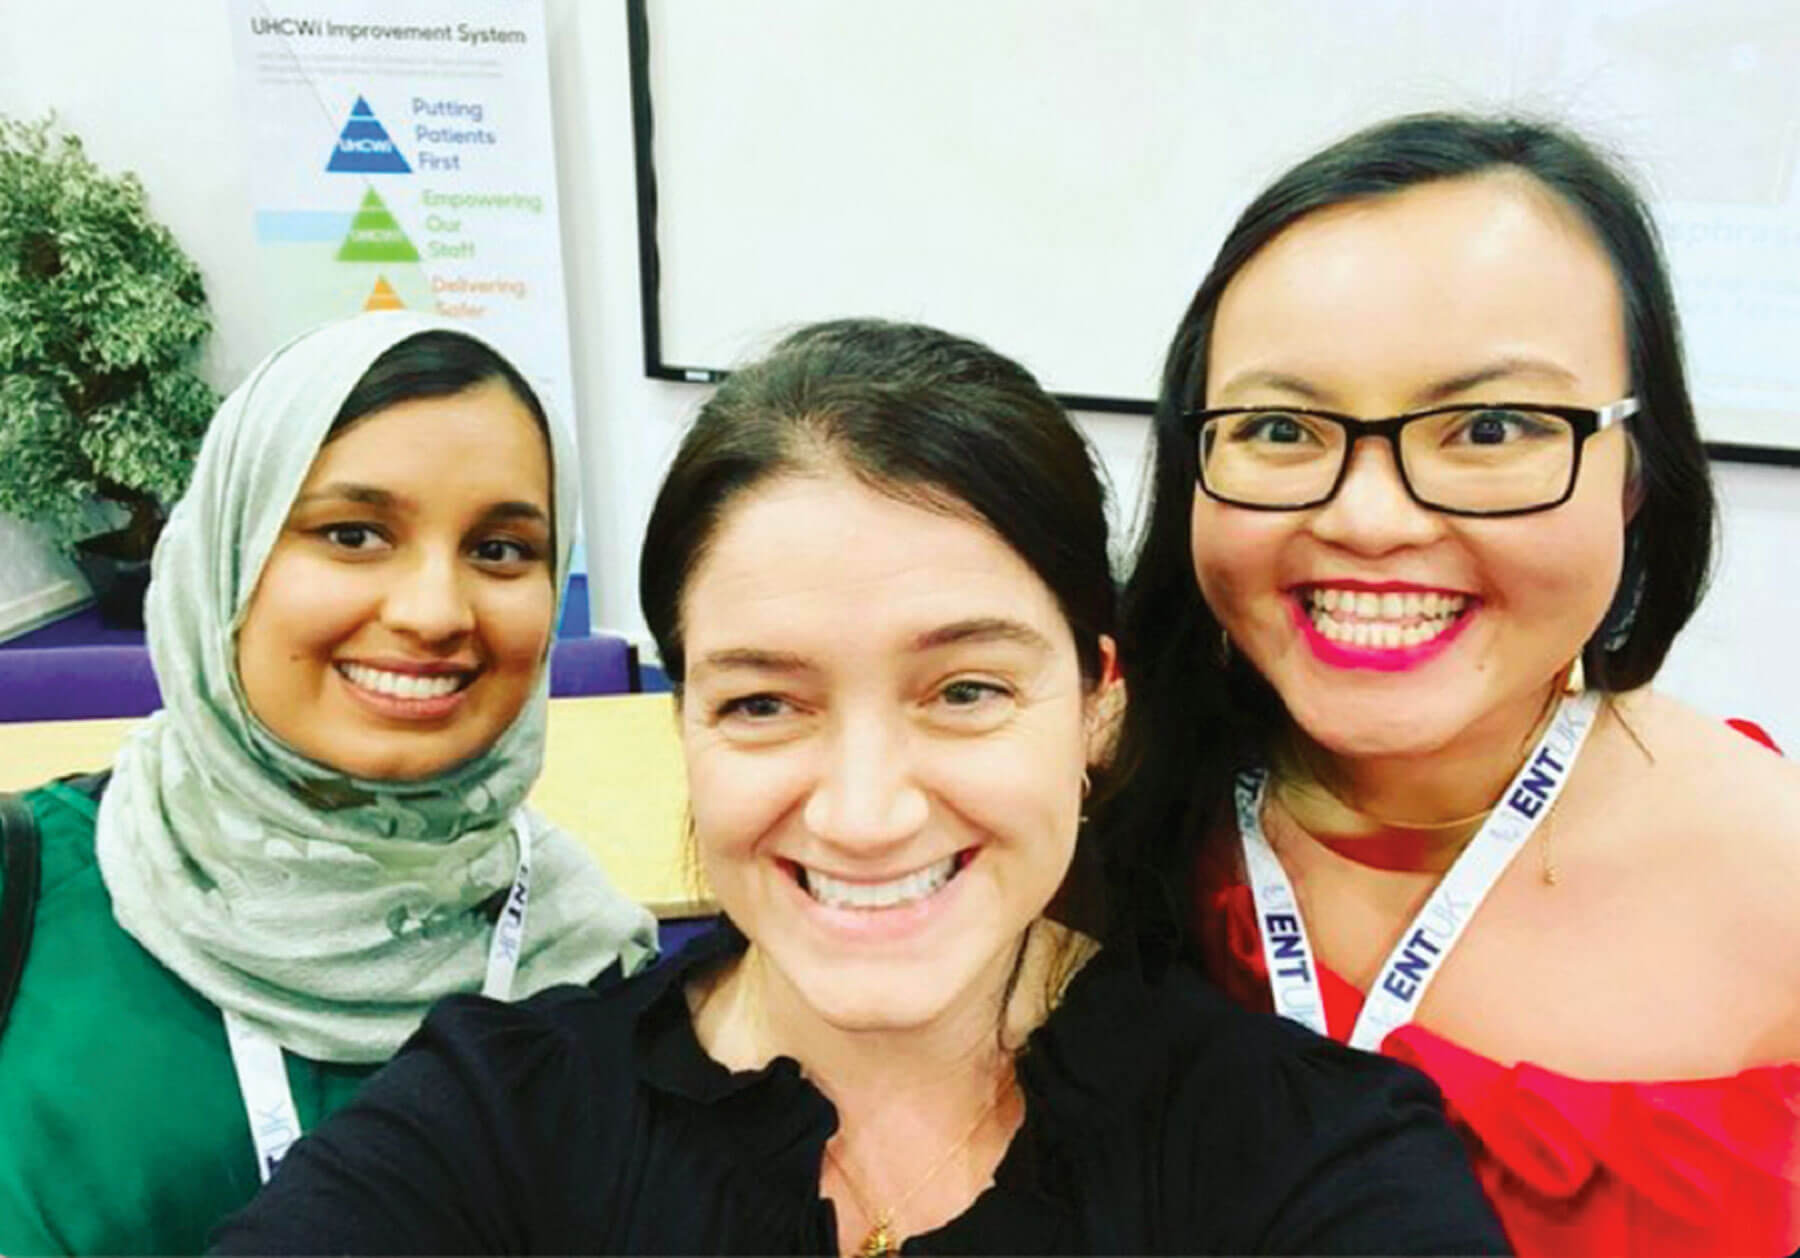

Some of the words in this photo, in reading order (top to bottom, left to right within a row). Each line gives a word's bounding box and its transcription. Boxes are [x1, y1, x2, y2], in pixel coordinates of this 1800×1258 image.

[327, 21, 451, 41] Improvement
[457, 24, 527, 45] System
[412, 97, 483, 122] Putting
[416, 124, 496, 144] Patients
[419, 151, 461, 170] First
[421, 189, 543, 213] Empowering
[426, 214, 460, 232] Our
[428, 240, 475, 258] Staff
[431, 275, 525, 299] Delivering
